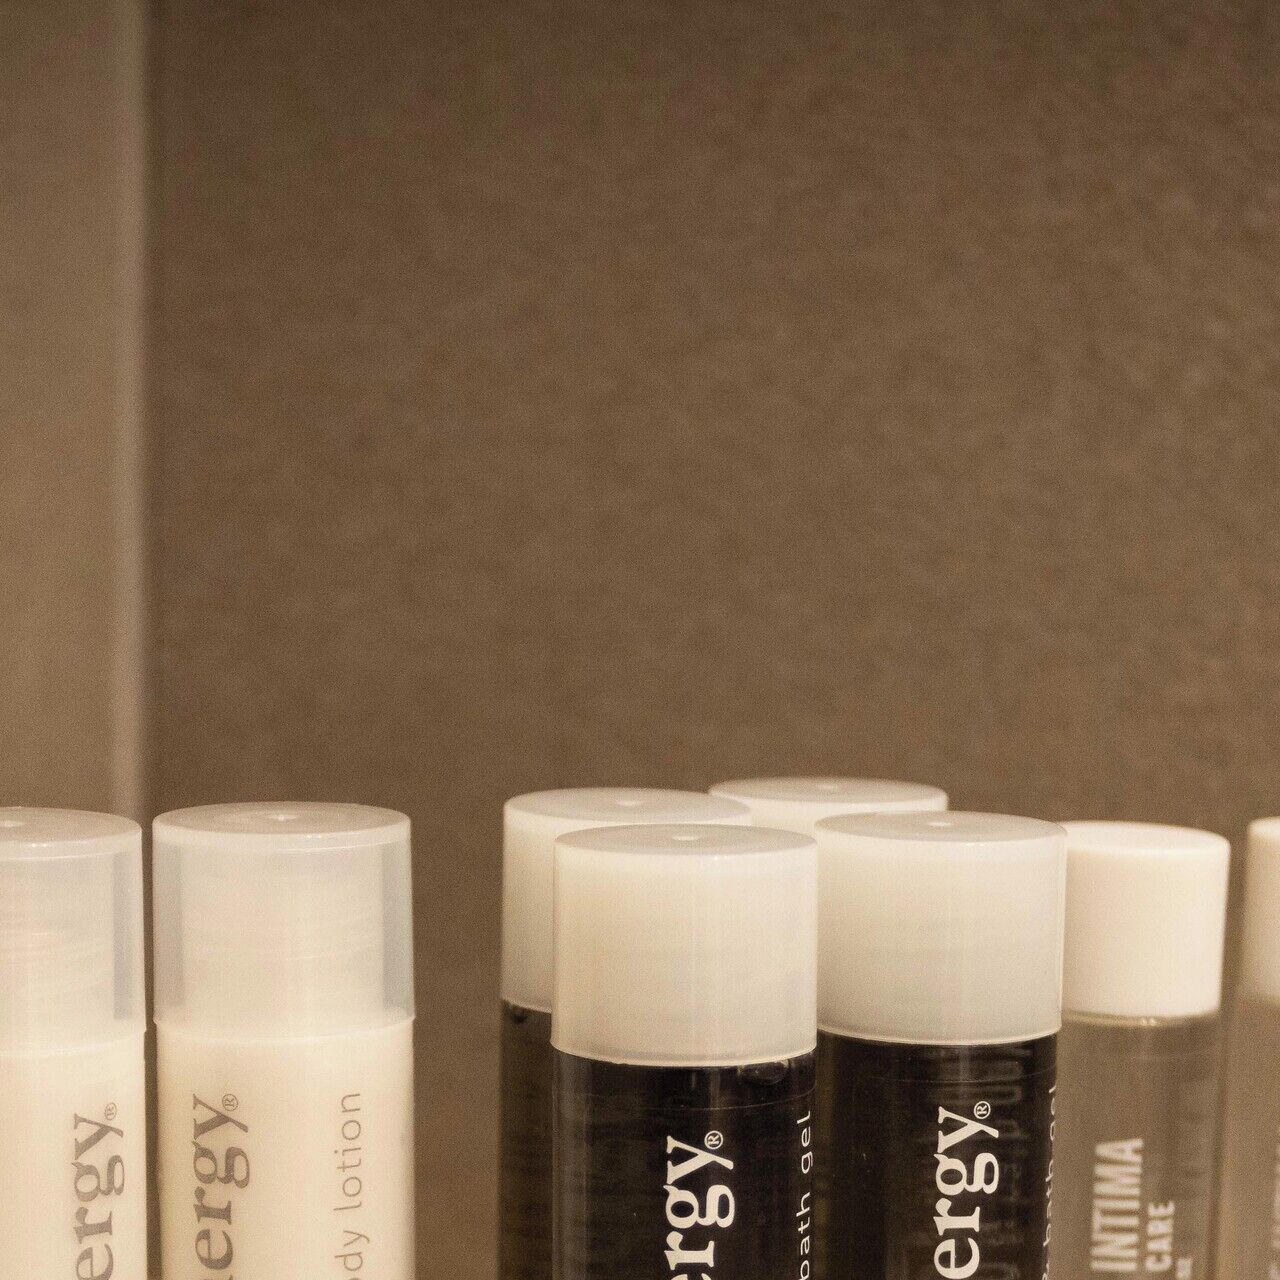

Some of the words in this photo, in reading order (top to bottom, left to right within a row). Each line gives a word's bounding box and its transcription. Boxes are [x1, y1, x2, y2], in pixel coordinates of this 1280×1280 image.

[334, 1091, 362, 1213] lotion
[796, 1110, 814, 1176] gel
[1089, 1137, 1144, 1273] INTIMA
[1144, 1199, 1176, 1273] CARE
